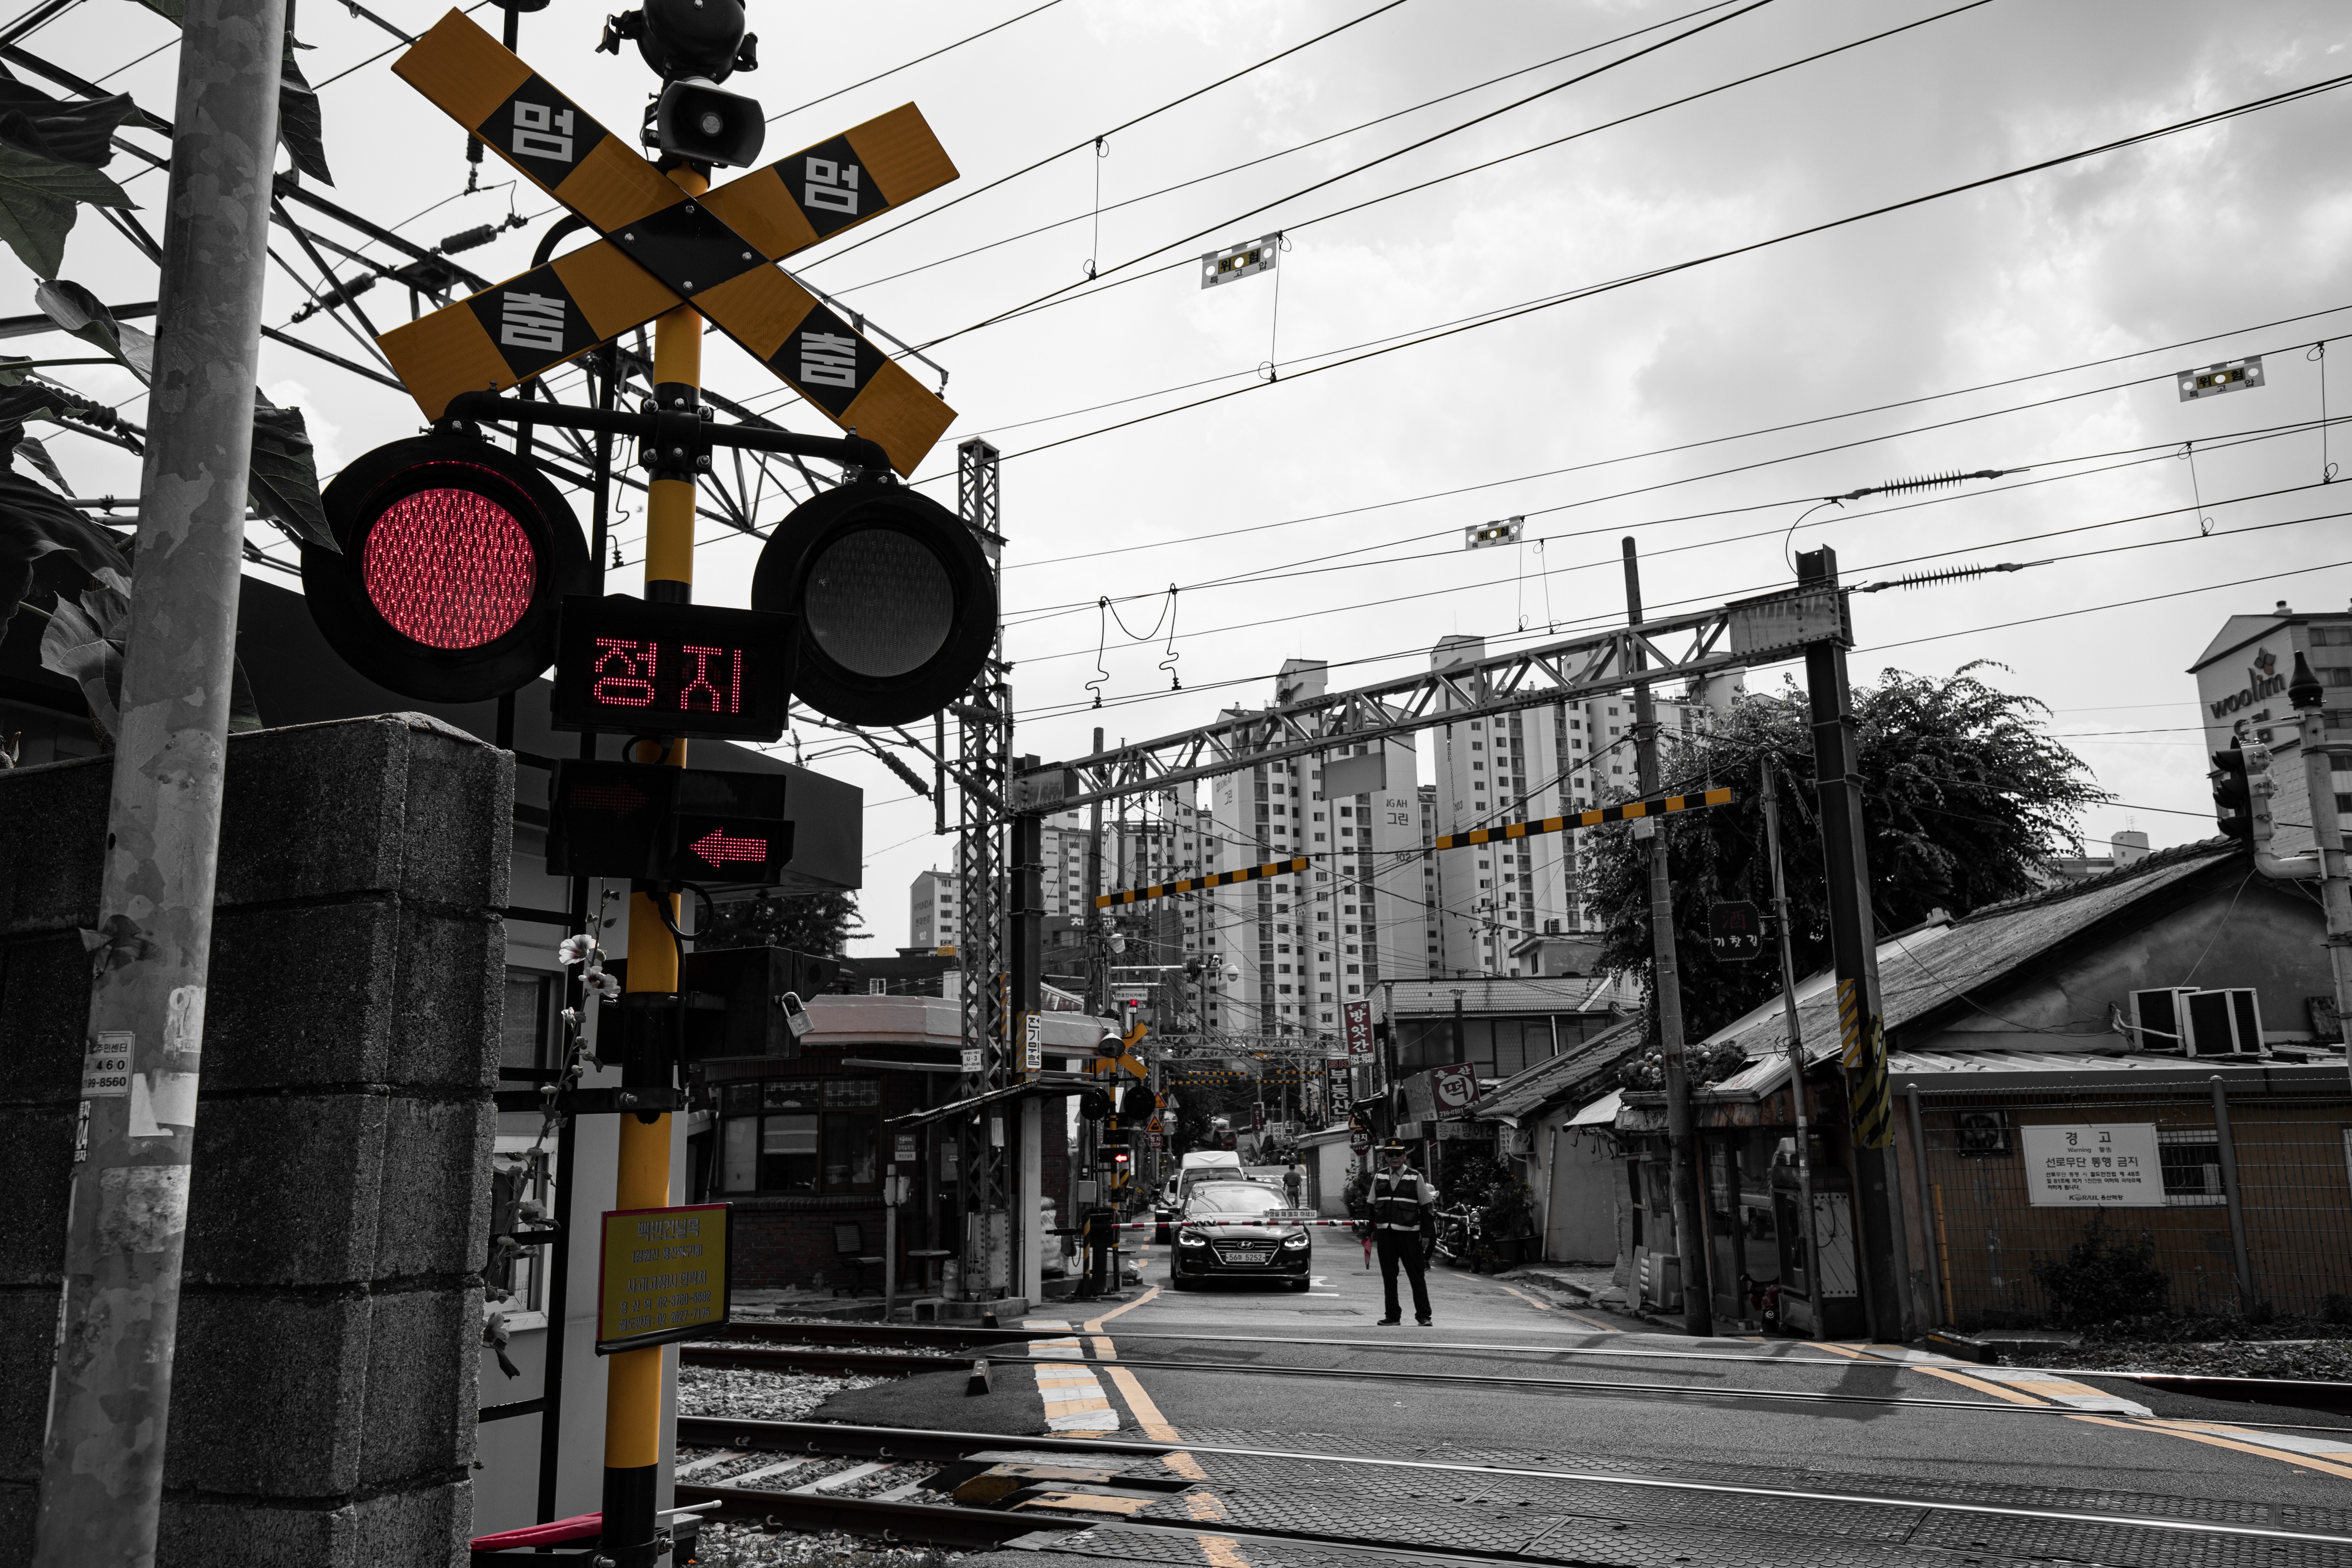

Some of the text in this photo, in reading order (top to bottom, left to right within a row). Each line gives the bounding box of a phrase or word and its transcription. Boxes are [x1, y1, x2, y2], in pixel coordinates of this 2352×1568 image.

[513, 101, 574, 162] 멈
[805, 156, 858, 215] 멈
[594, 638, 741, 714] 정지
[2210, 667, 2286, 719] woolim
[1396, 799, 1407, 808] AH
[1387, 812, 1409, 825] 그린
[914, 898, 934, 912] HYUNDAI
[1722, 910, 1746, 930] 酒
[1349, 1009, 1369, 1052] 방앗간
[1028, 1017, 1040, 1066] 전기위험
[96, 1060, 125, 1070] 460
[1330, 1069, 1351, 1115] 부동산
[1442, 1077, 1468, 1101] 떡
[1353, 1133, 1368, 1142] 정지
[2066, 1132, 2112, 1145] 경고
[2046, 1156, 2139, 1168] 선로무단 통행 금지
[637, 1217, 700, 1242] 백빈건널목
[679, 1269, 707, 1287] 연락처
[657, 1290, 711, 1309] 02-3780-5592
[657, 1313, 667, 1326] 02
[669, 1306, 710, 1323] 2027-7175
